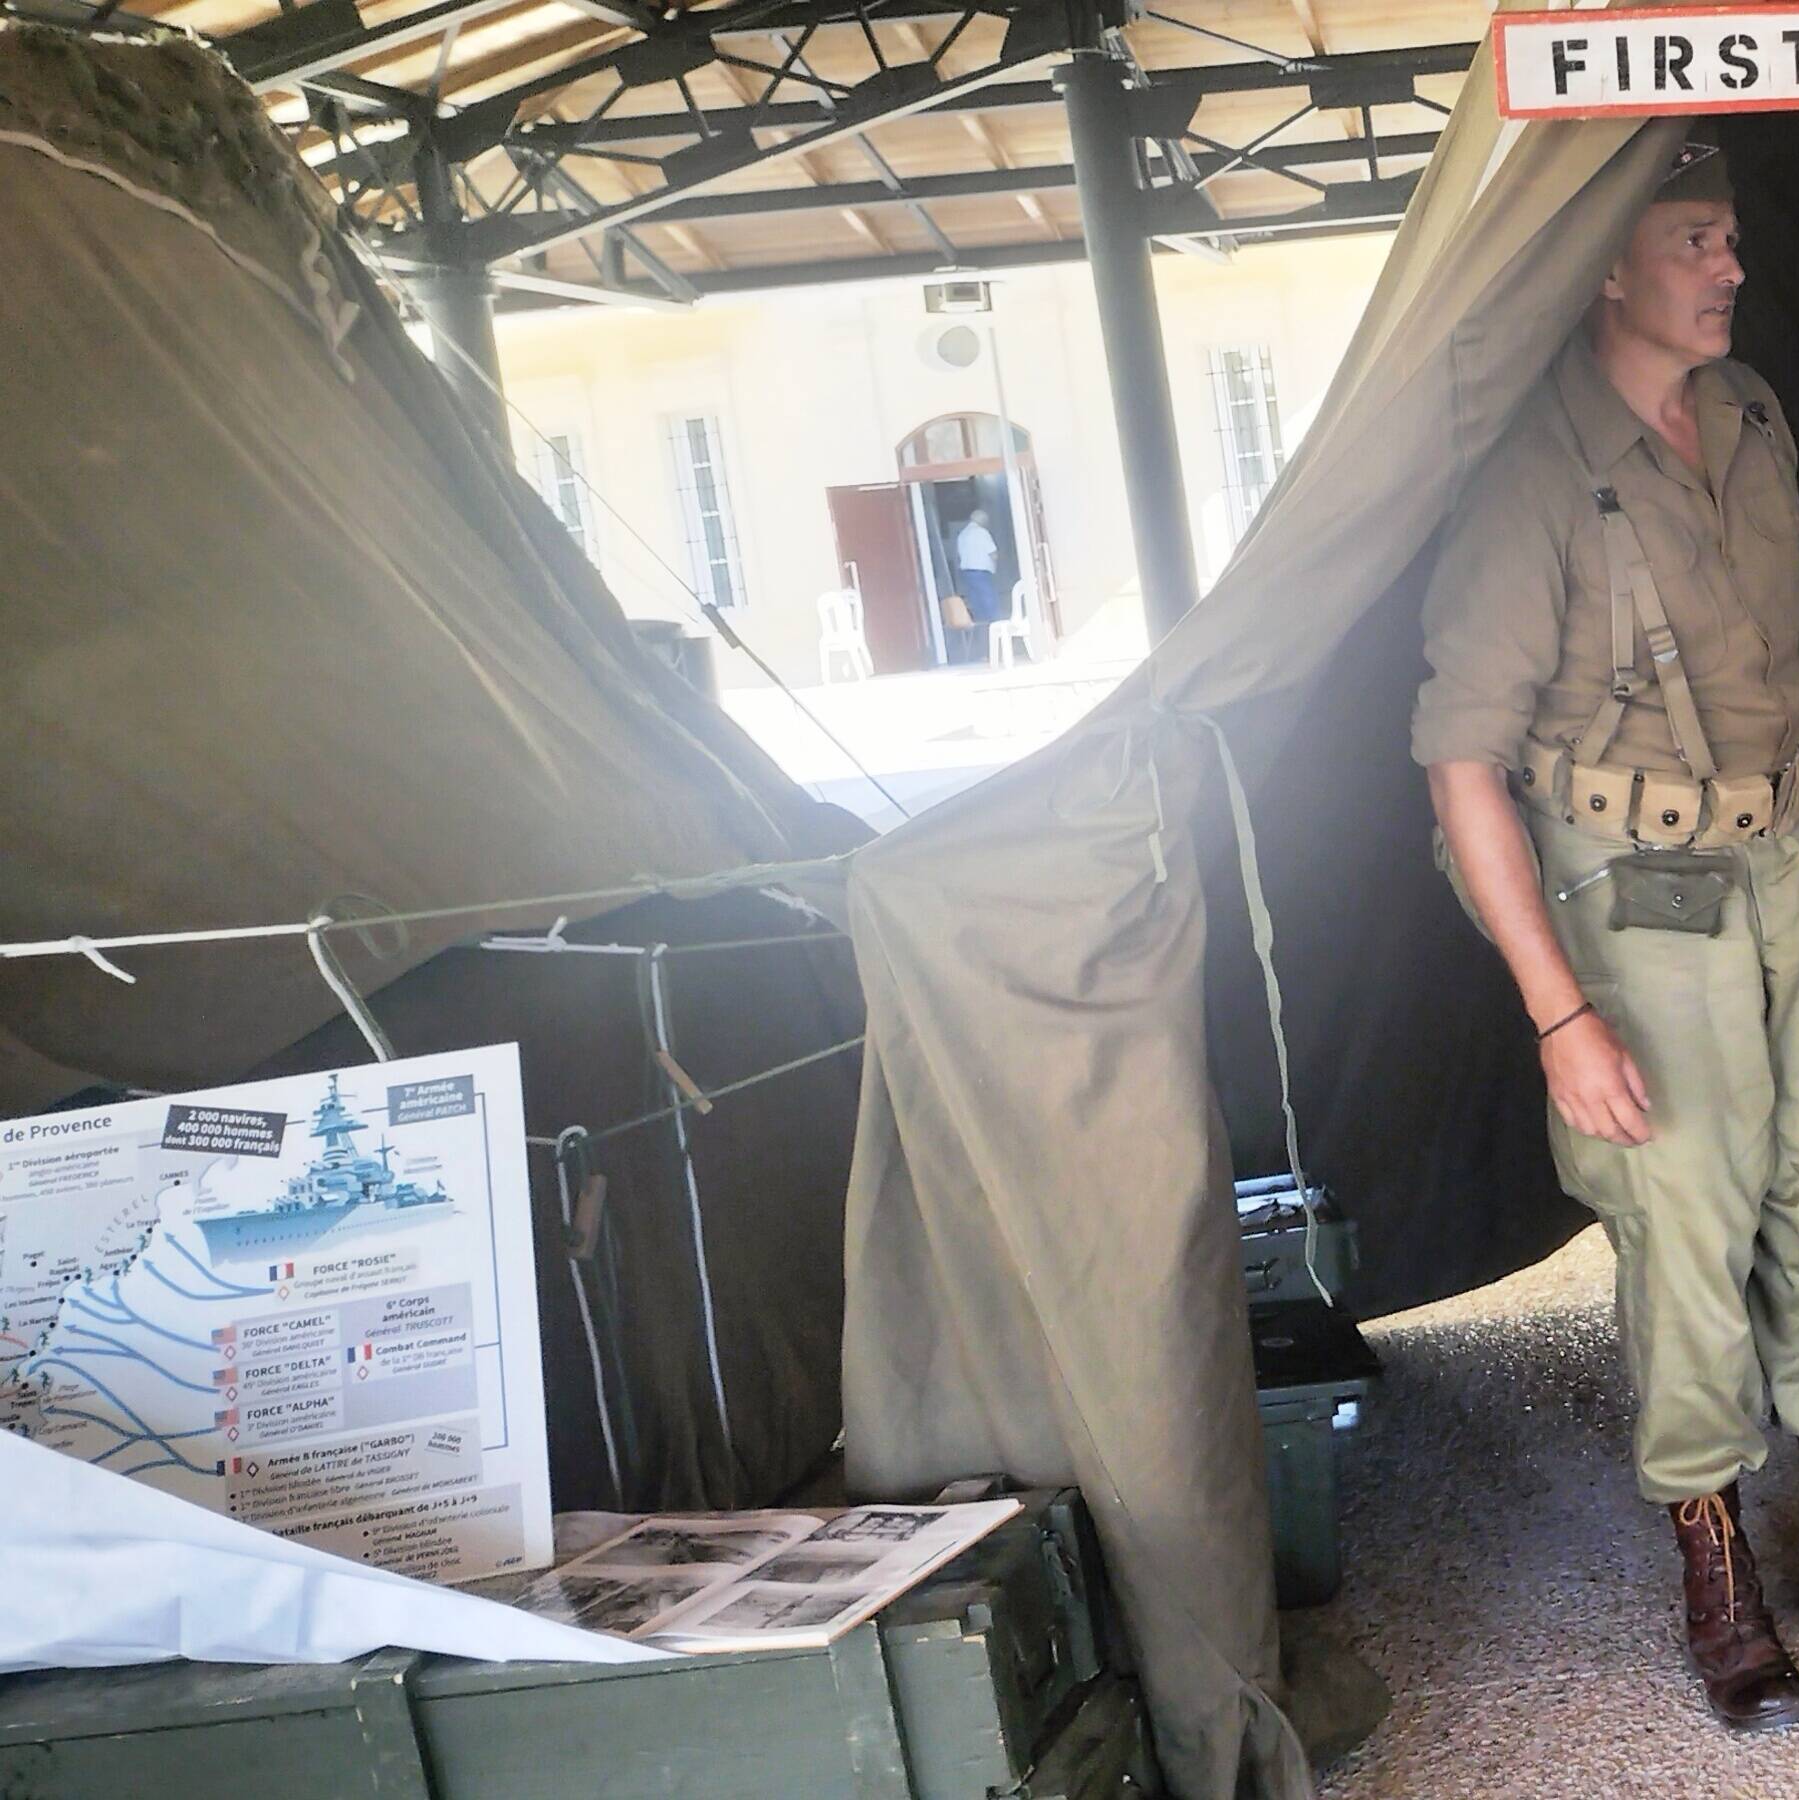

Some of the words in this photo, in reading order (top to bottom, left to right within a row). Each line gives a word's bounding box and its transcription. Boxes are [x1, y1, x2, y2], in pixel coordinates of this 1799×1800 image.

[3, 1128, 25, 1143] de
[30, 1116, 112, 1140] Provence
[220, 1113, 267, 1128] navires,
[223, 1125, 273, 1140] hommes
[165, 1135, 187, 1146] dont
[233, 1138, 280, 1154] français
[312, 1260, 349, 1275] FORCE
[351, 1253, 397, 1268] "ROSIE"
[398, 1296, 430, 1308] Corps
[243, 1323, 280, 1339] FORCE
[282, 1314, 332, 1331] "CAMEL"
[382, 1306, 436, 1323] américain
[375, 1341, 414, 1356] Combat
[416, 1332, 467, 1348] Command
[245, 1364, 282, 1379] FORCE
[284, 1355, 332, 1372] "DELTA"
[247, 1404, 283, 1420] FORCE
[286, 1395, 335, 1413] "ALPHA"
[267, 1455, 301, 1468] Armée
[311, 1444, 359, 1461] française
[314, 1459, 350, 1473] LATTRE
[364, 1447, 411, 1464] TASSIGNY
[312, 1516, 354, 1531] français
[355, 1504, 416, 1525] débarquant
[416, 1503, 430, 1513] de
